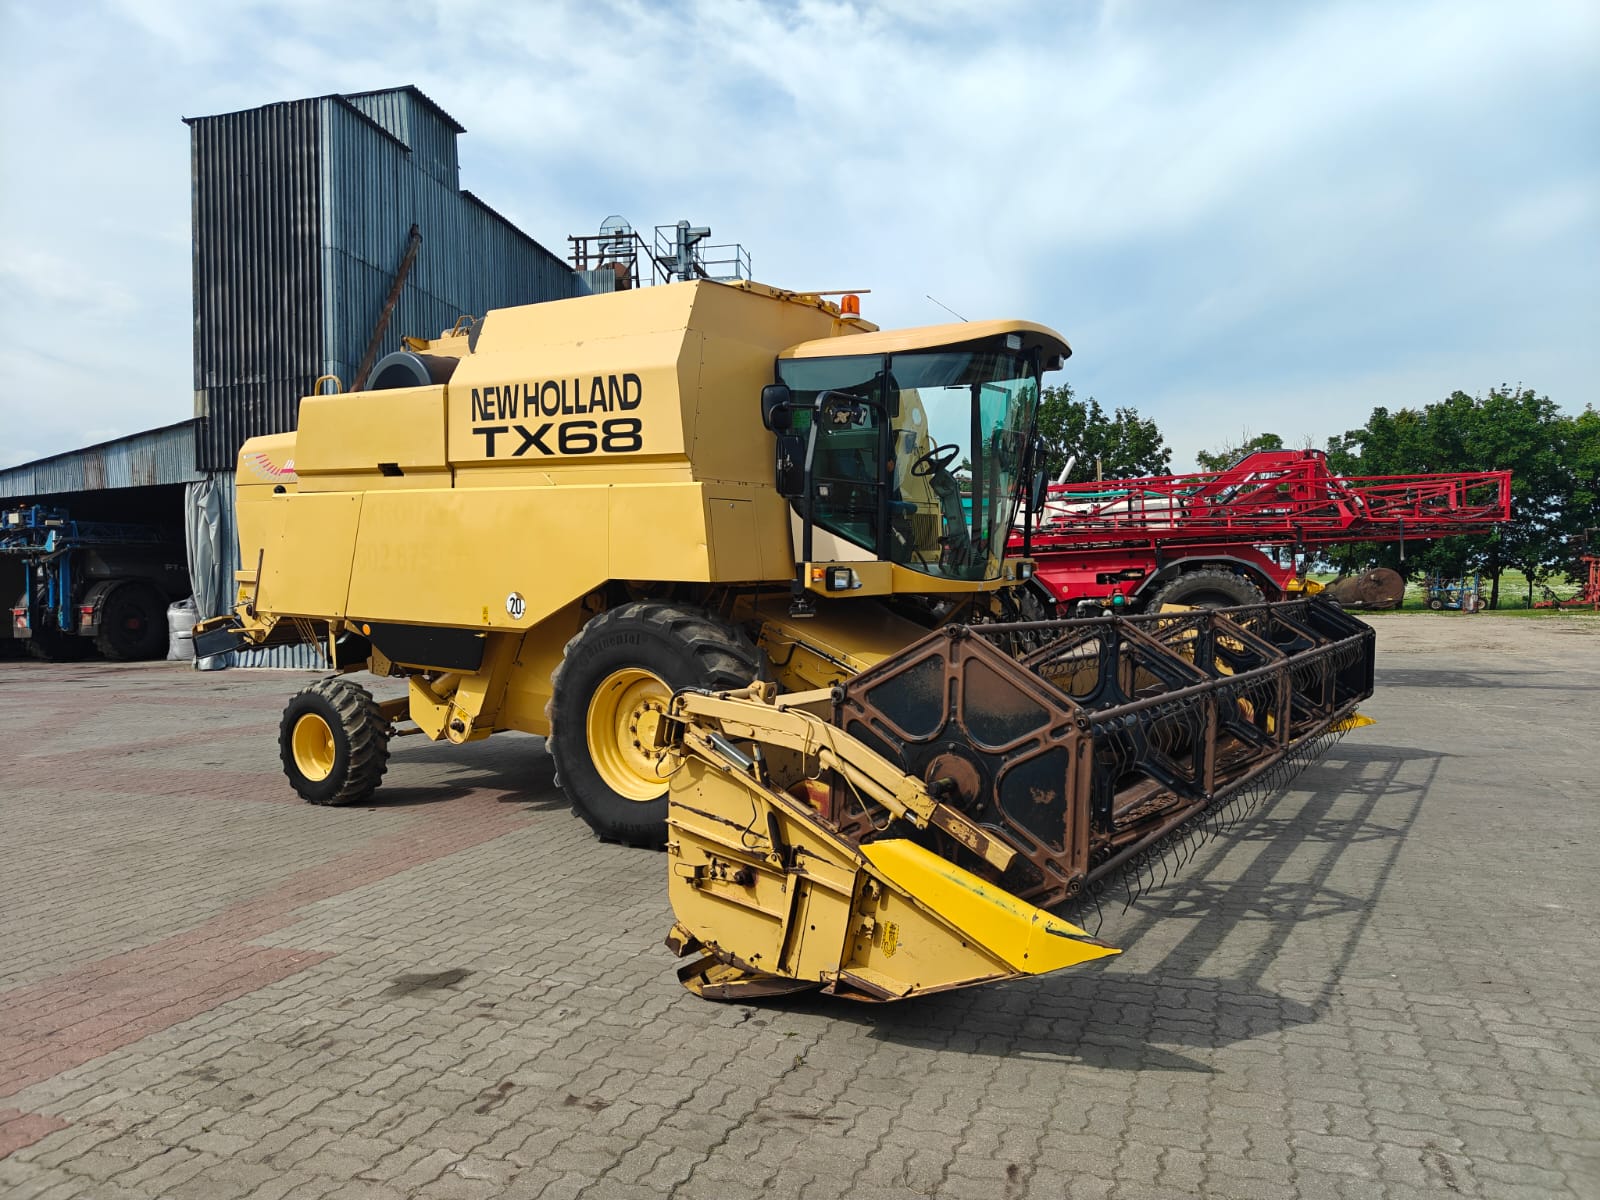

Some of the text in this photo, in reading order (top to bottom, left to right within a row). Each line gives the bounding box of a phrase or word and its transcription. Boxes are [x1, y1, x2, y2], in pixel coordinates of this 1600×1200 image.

[471, 373, 643, 422] NEW HOLLAND
[472, 417, 643, 458] TX68
[509, 597, 522, 615] 20
